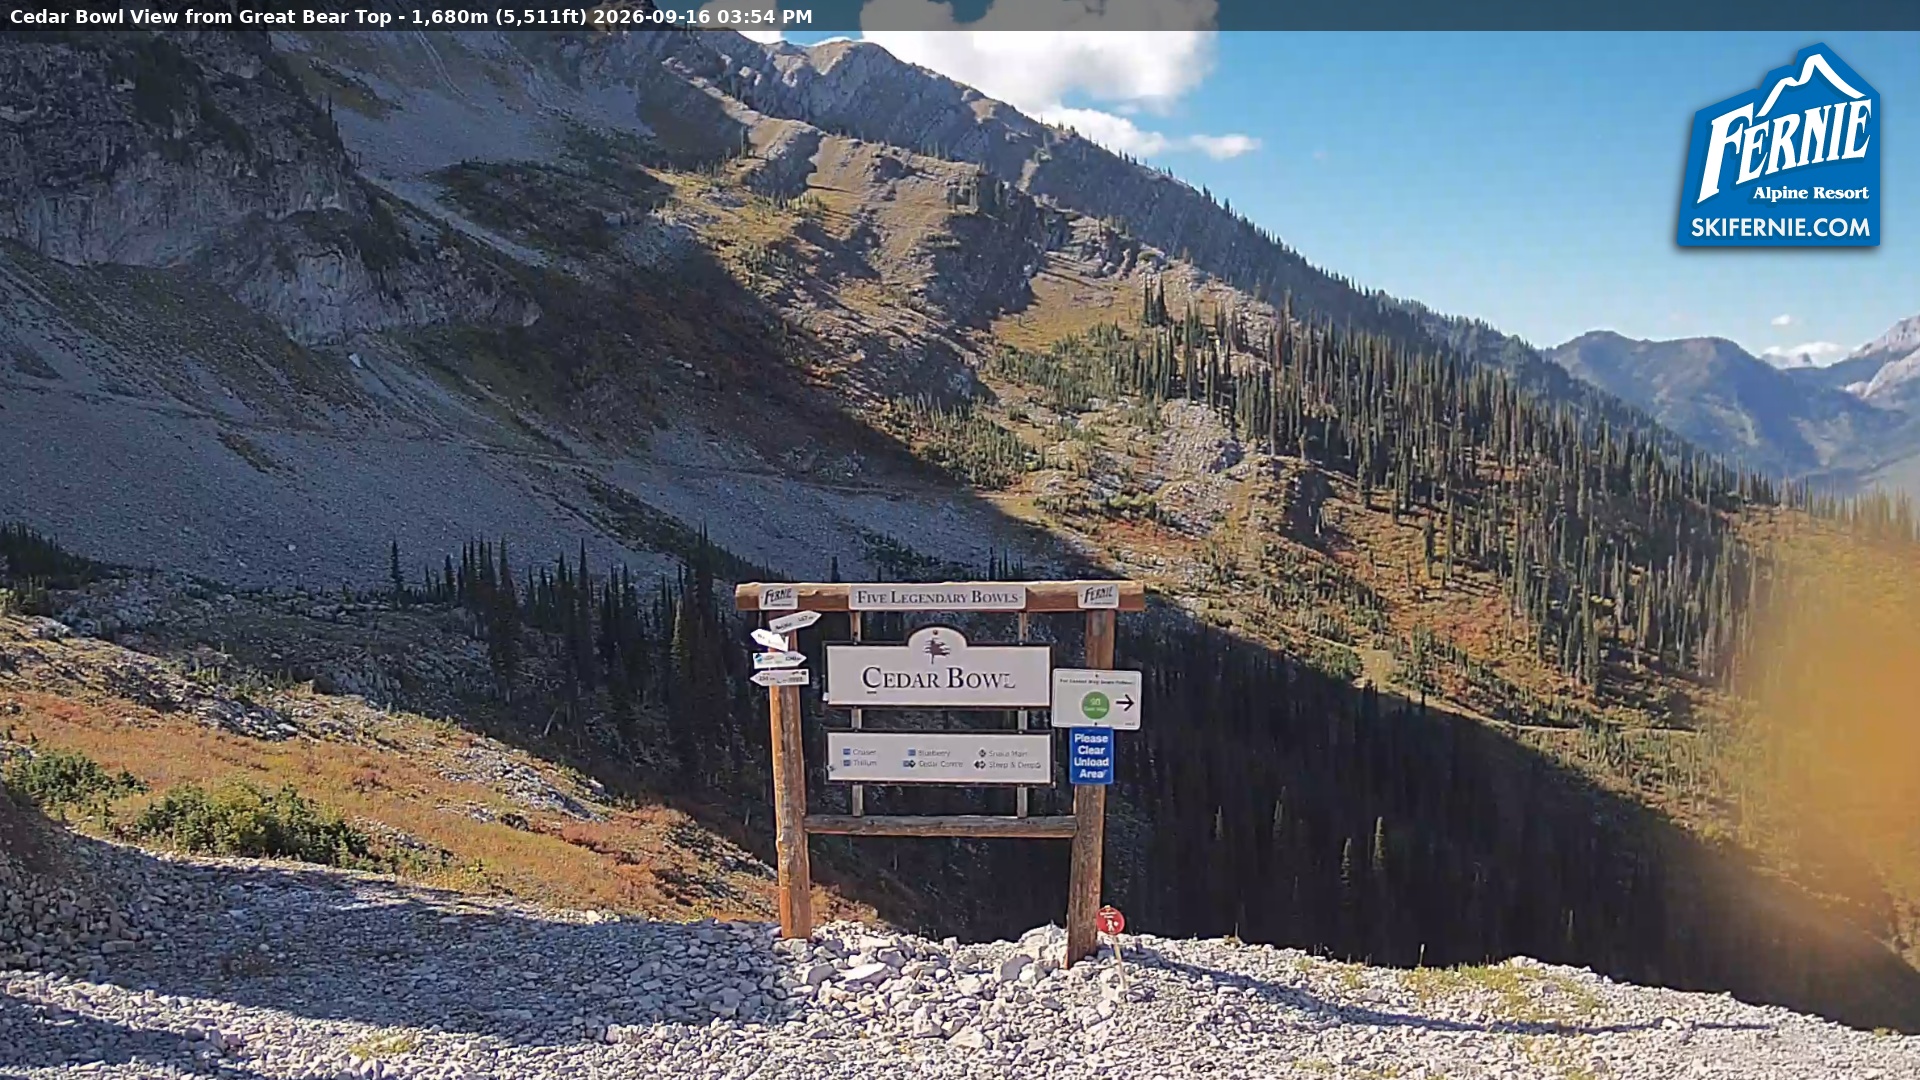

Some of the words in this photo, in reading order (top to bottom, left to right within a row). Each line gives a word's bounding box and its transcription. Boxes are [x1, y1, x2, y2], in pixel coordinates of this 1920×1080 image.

[857, 590, 887, 604] FIVE
[890, 590, 968, 604] LEGENDARY
[971, 590, 1020, 604] BOWLS
[862, 666, 940, 689] CEDAR
[946, 667, 1016, 689] BOWL
[1074, 733, 1109, 743] Please
[1078, 745, 1106, 755] Clear
[1074, 757, 1110, 767] Unload
